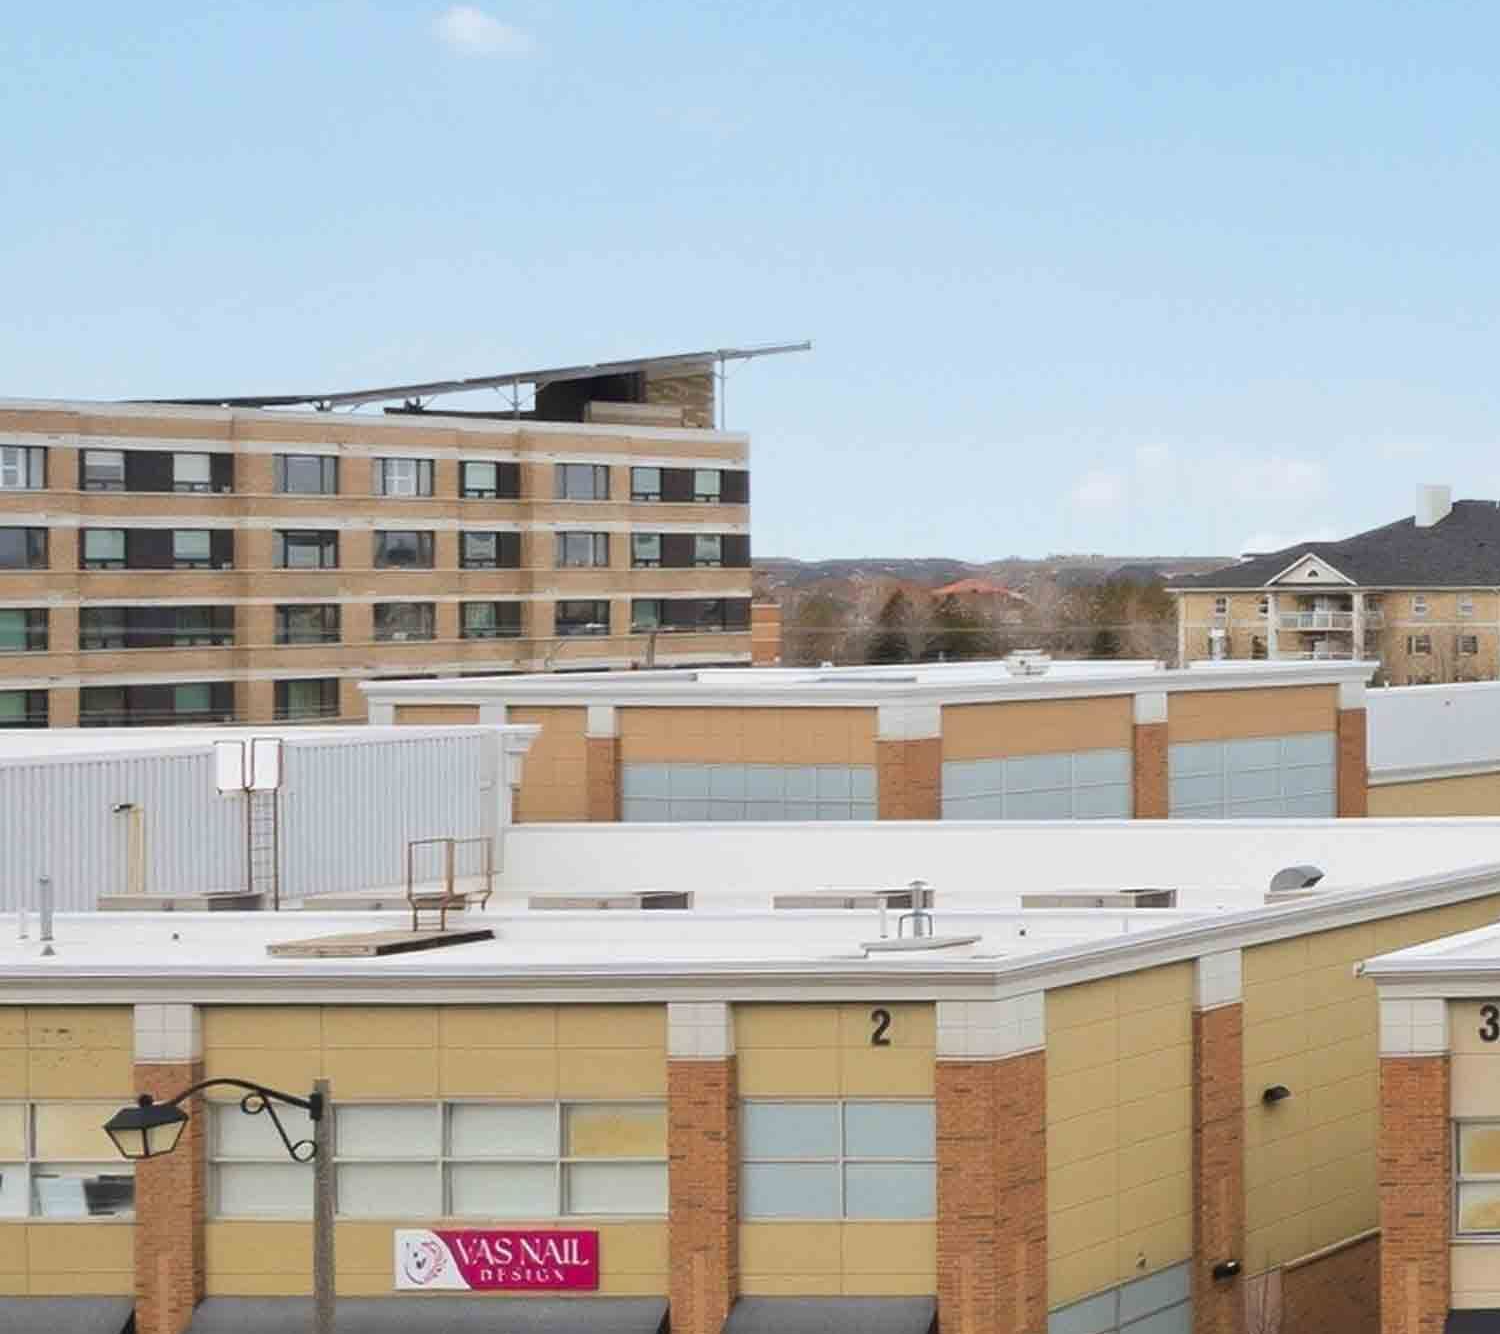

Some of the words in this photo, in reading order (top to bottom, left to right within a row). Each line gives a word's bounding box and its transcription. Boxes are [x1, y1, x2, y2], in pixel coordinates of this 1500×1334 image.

[872, 1010, 891, 1047] 2
[455, 1237, 514, 1266] VAS
[519, 1237, 590, 1266] NAIL
